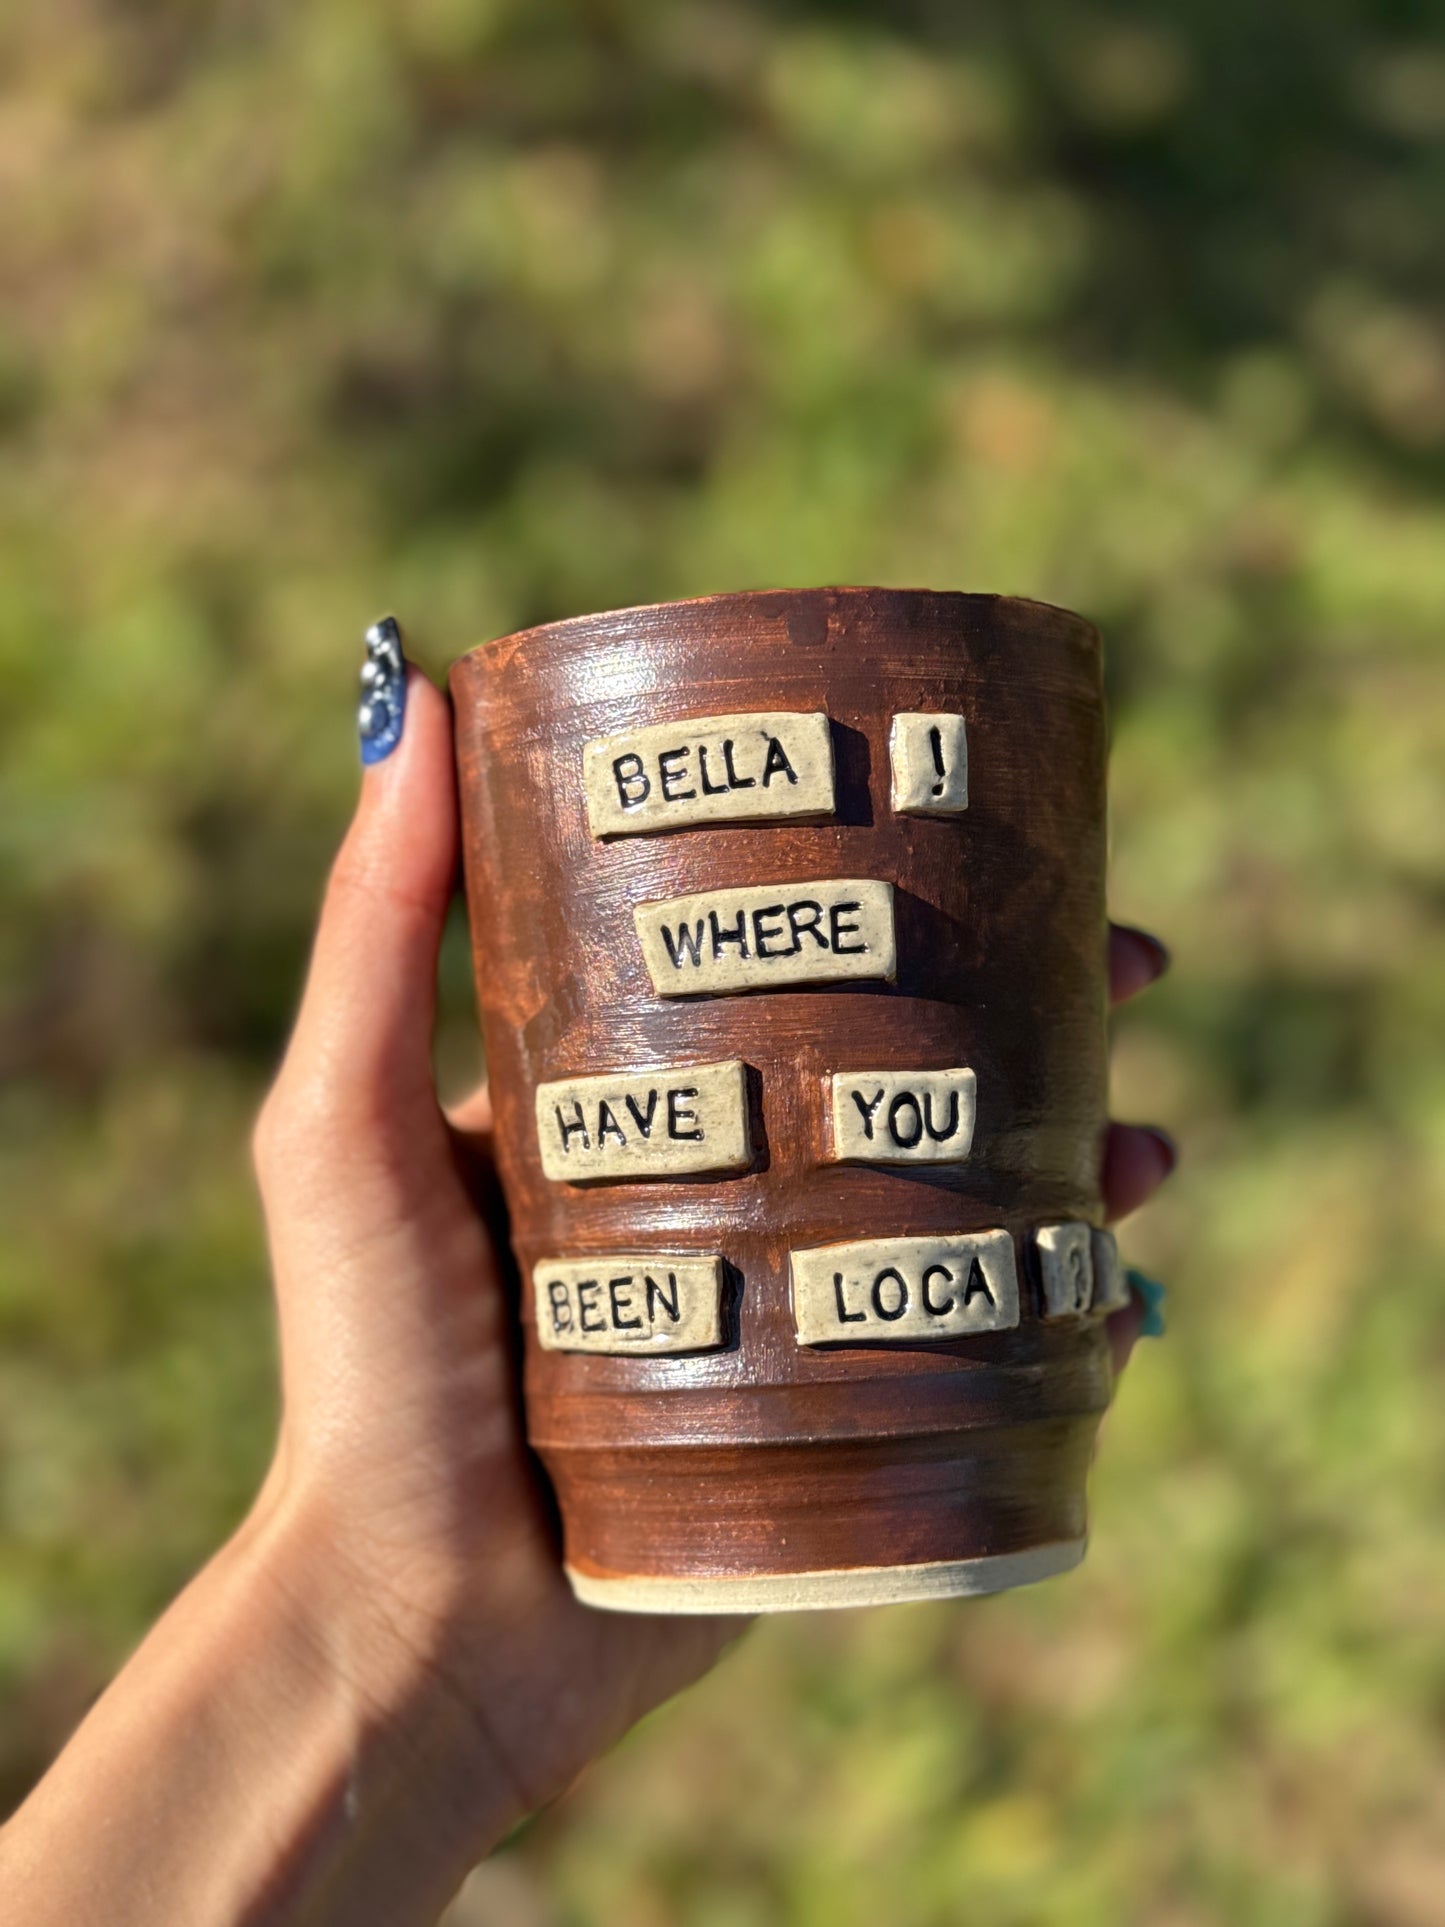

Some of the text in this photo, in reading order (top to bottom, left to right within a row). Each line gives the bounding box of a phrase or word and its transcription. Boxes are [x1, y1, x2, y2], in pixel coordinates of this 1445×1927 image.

[612, 725, 946, 809] BELLA !
[660, 900, 869, 969] WHERE
[555, 1087, 959, 1153] HAVE YOU
[547, 1272, 681, 1334] BEEN
[833, 1256, 996, 1323] LOCA
